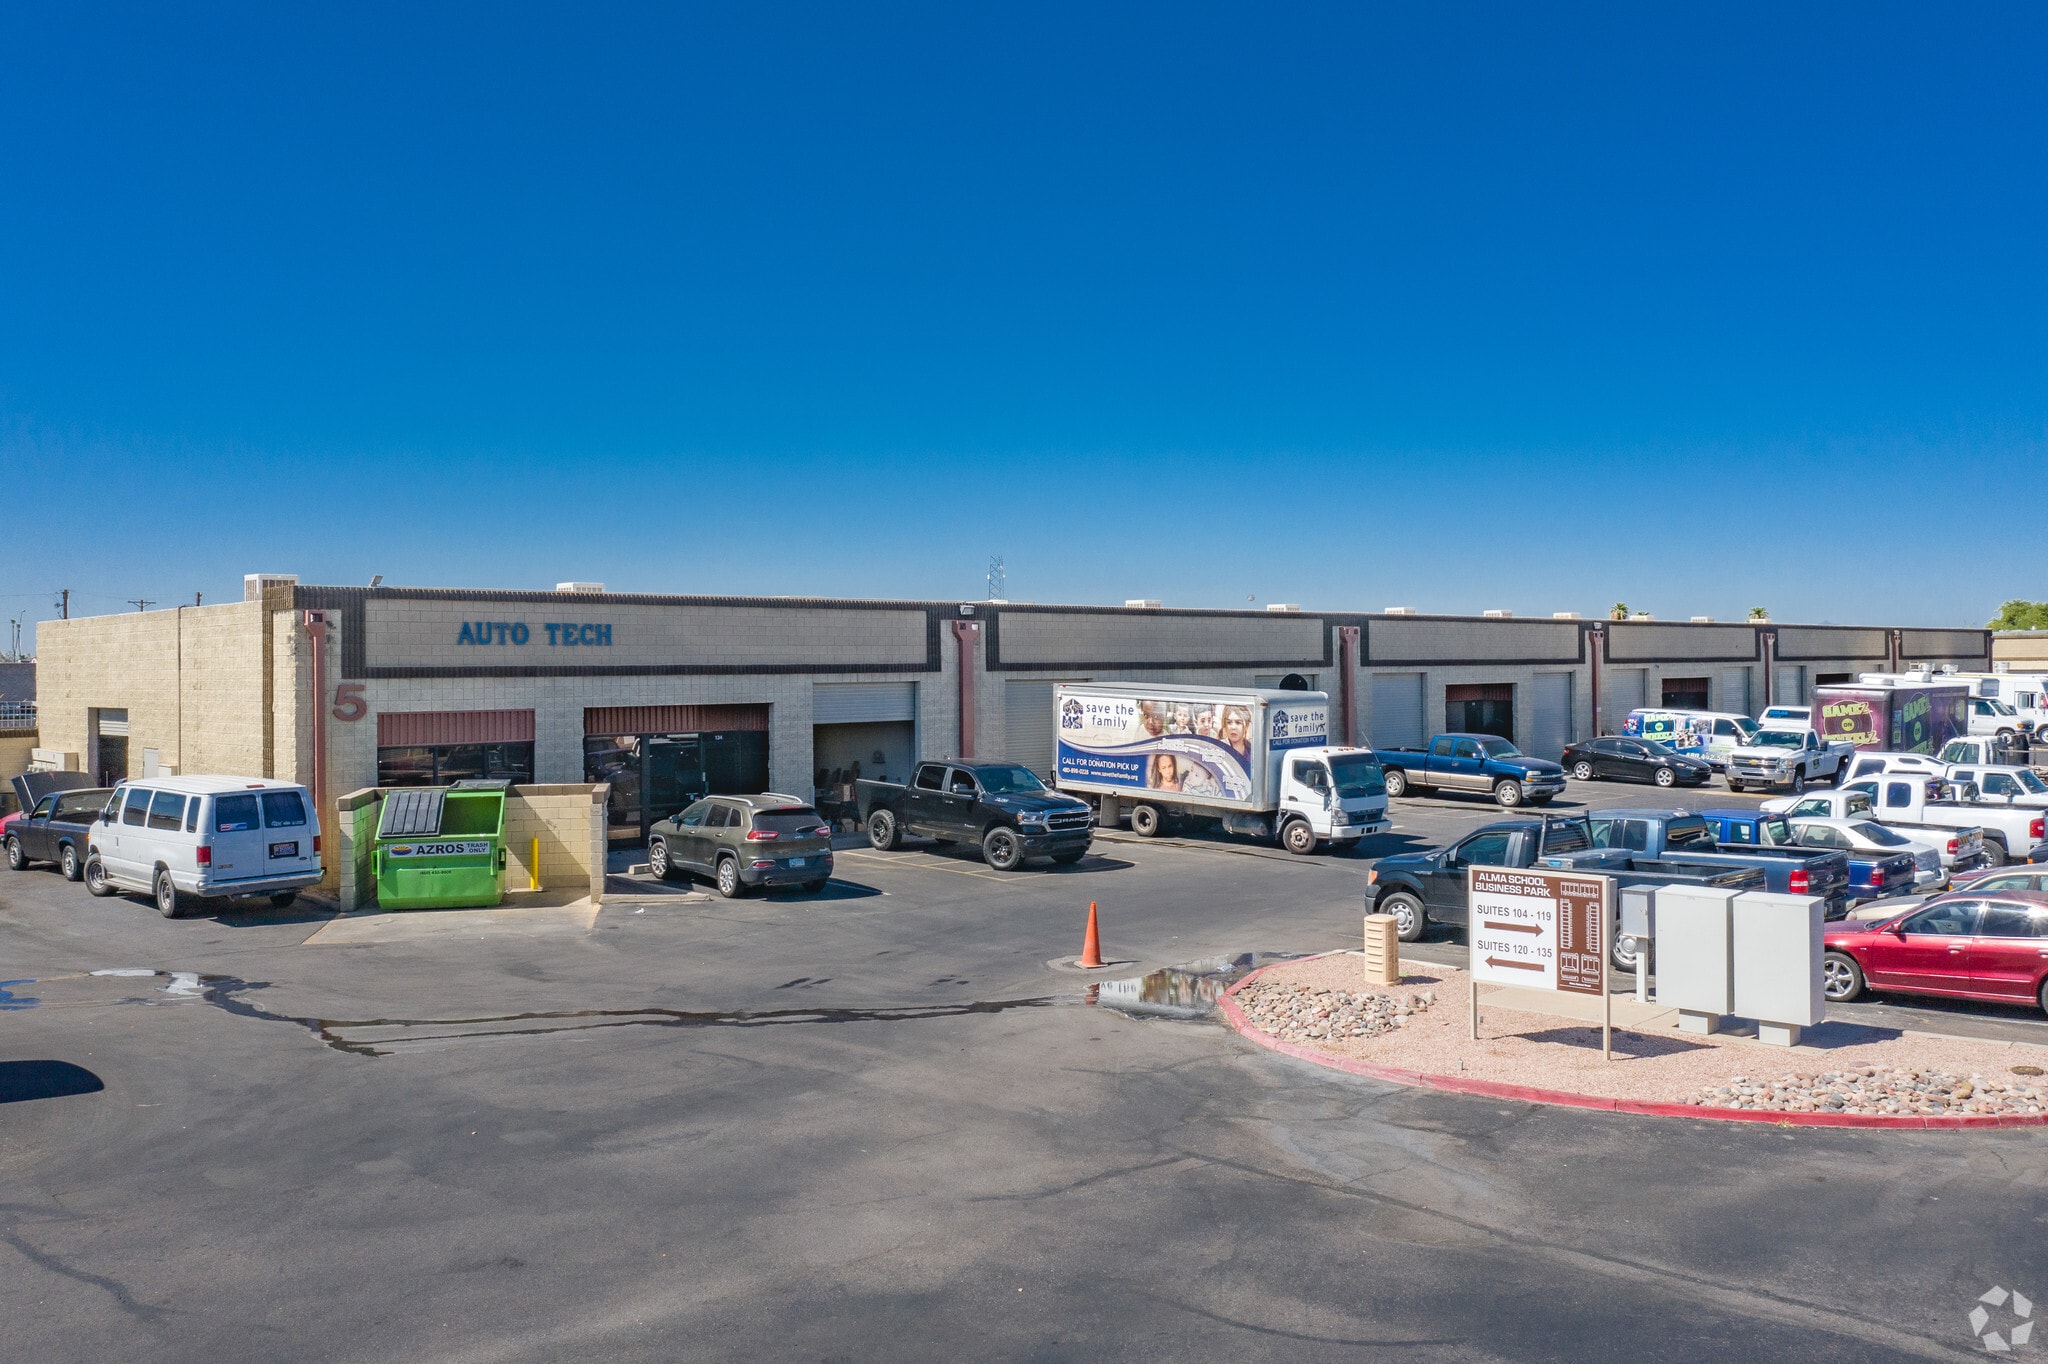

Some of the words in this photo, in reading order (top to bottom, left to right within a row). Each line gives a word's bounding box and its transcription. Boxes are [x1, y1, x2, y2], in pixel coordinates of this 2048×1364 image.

[457, 621, 530, 646] AUTO
[544, 622, 613, 646] TECH
[332, 684, 368, 722] 5
[1086, 703, 1111, 714] save
[1115, 703, 1135, 716] the
[1092, 714, 1128, 730] family
[1290, 713, 1308, 723] save
[1311, 711, 1325, 721] the
[1294, 723, 1320, 735] family
[1062, 757, 1075, 765] CALL
[1076, 758, 1088, 767] FOR
[1088, 760, 1116, 769] DONATION
[1117, 762, 1130, 770] PICK
[416, 843, 465, 855] AZROS
[1478, 872, 1507, 883] ALMA
[1508, 874, 1547, 887] SCHOOL
[1475, 882, 1522, 895] BUSINESS
[1524, 886, 1551, 897] PARK
[1477, 904, 1510, 917] SUITES
[1513, 908, 1528, 919] 104
[1536, 911, 1551, 921] 119
[1477, 940, 1510, 953] SUITES
[1513, 944, 1528, 955] 120
[1537, 947, 1553, 958] 135
